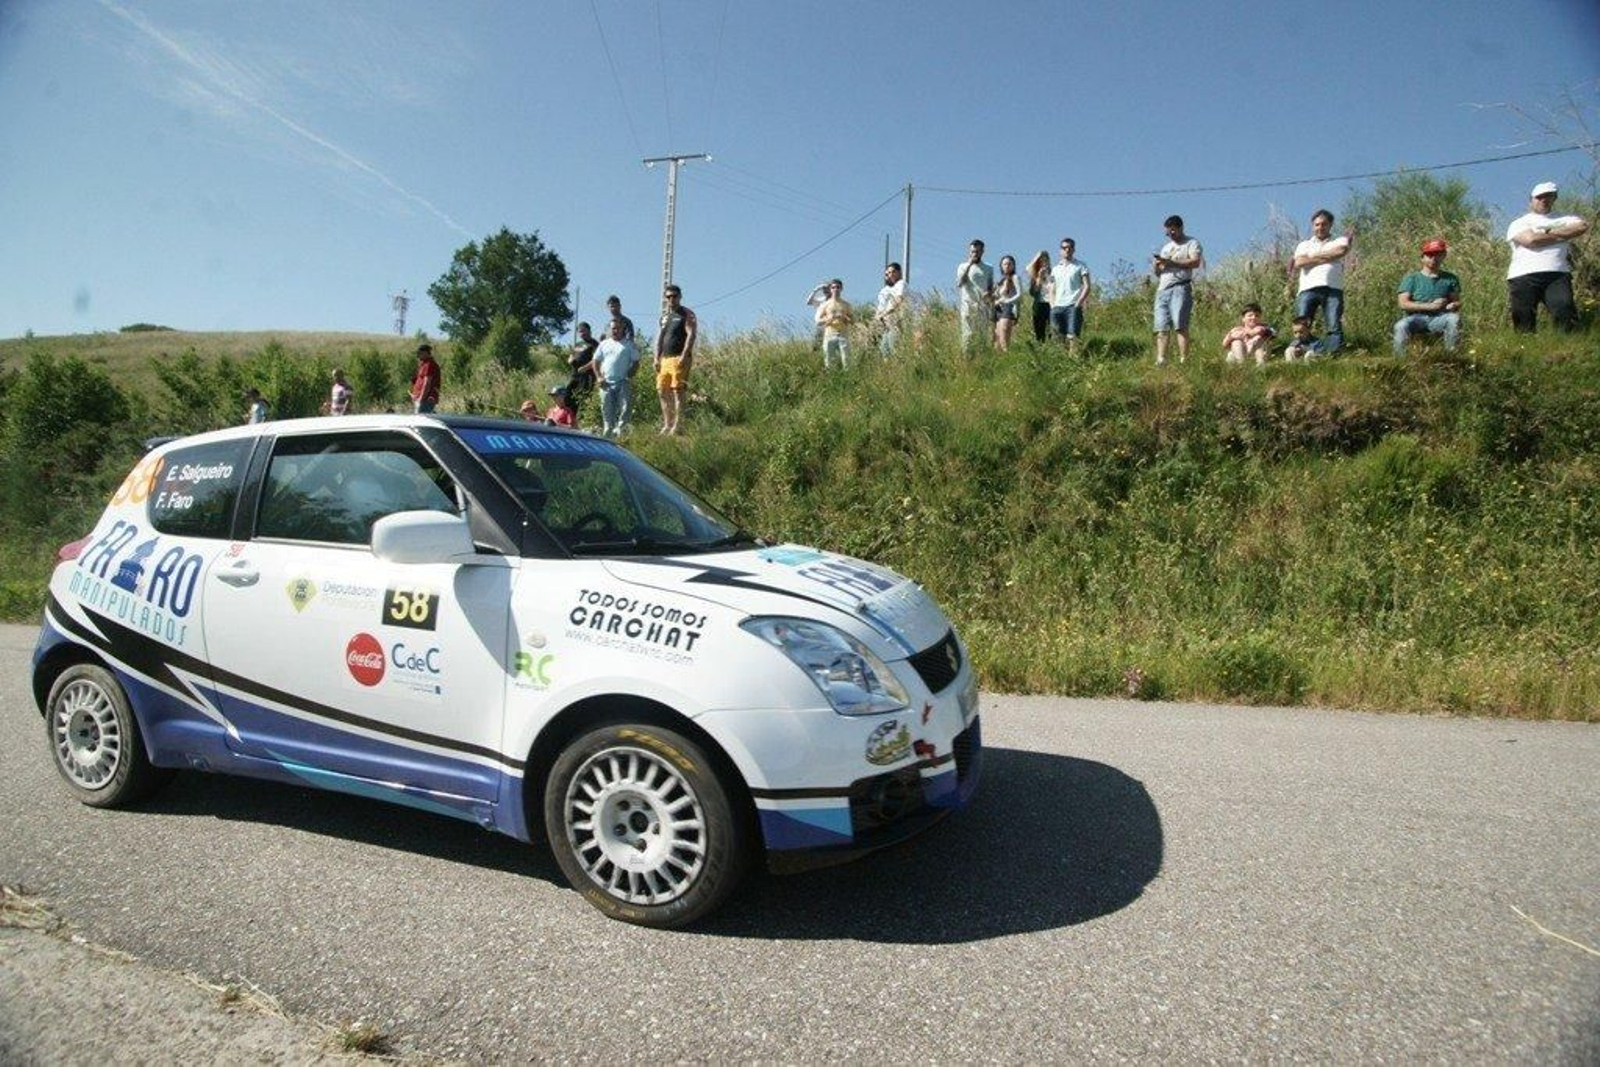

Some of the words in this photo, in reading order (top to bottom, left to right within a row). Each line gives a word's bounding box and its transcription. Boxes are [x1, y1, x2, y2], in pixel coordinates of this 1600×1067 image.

[179, 461, 233, 484] Salgueiro
[155, 492, 168, 509] F.
[167, 492, 194, 510] Faro
[68, 570, 188, 646] MANIPULADOS
[390, 588, 430, 623] 58
[578, 589, 639, 613] TODOS
[641, 602, 707, 629] SOMOS
[569, 606, 701, 652] CARCHAT
[391, 643, 440, 674] CdeC
